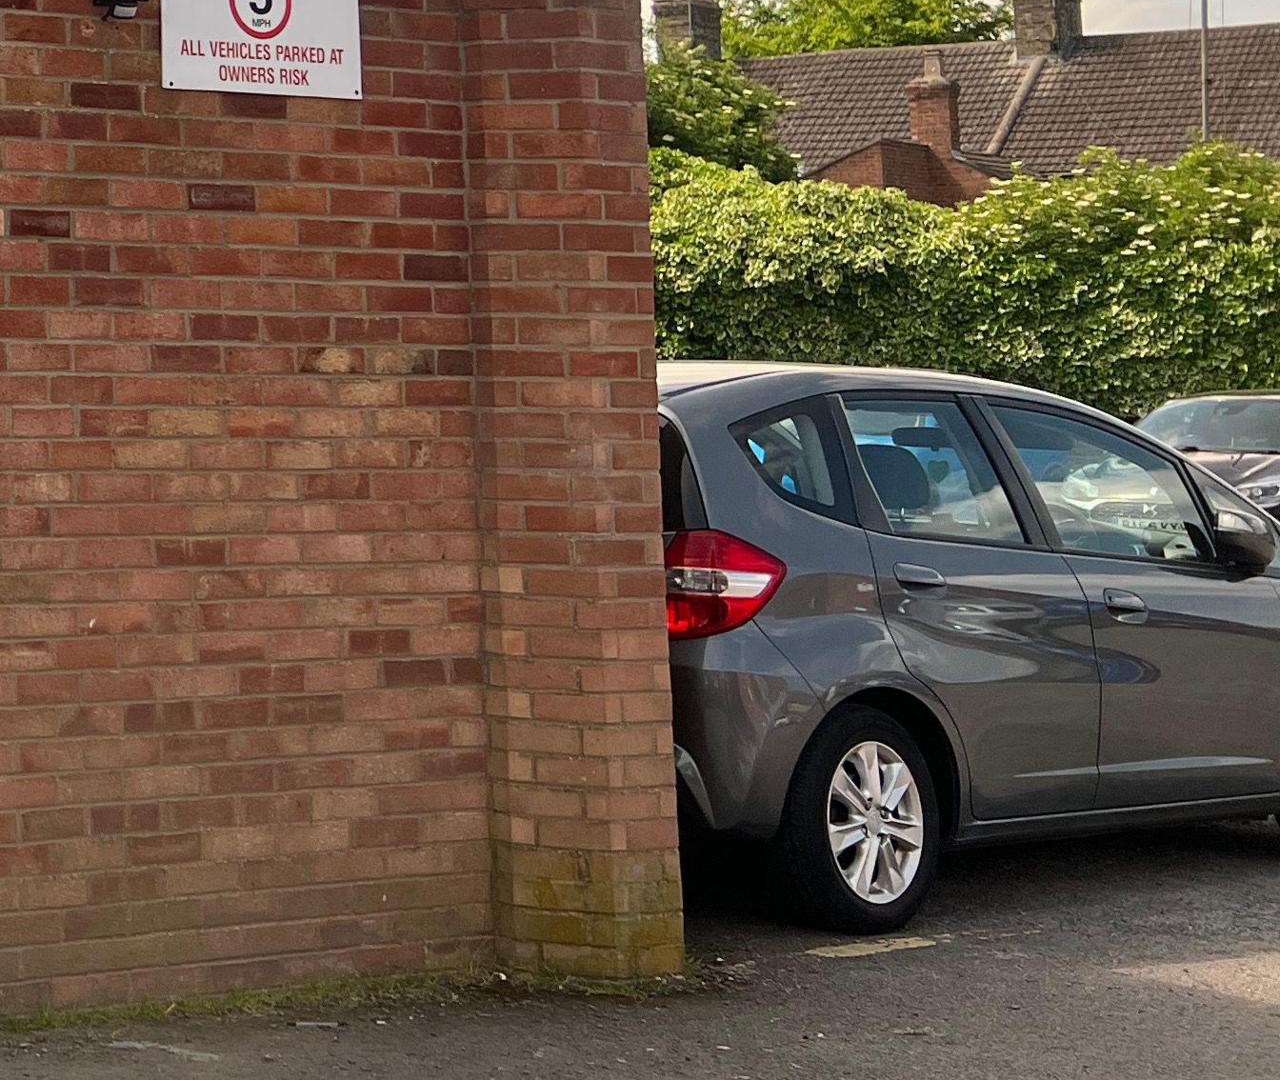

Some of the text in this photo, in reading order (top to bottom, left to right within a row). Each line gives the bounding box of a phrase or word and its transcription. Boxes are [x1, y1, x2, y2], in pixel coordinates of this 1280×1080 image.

[252, 19, 271, 28] MPH
[181, 40, 344, 64] ALL VEHICLES PARKED AT
[219, 65, 309, 86] OWNERS RISK
